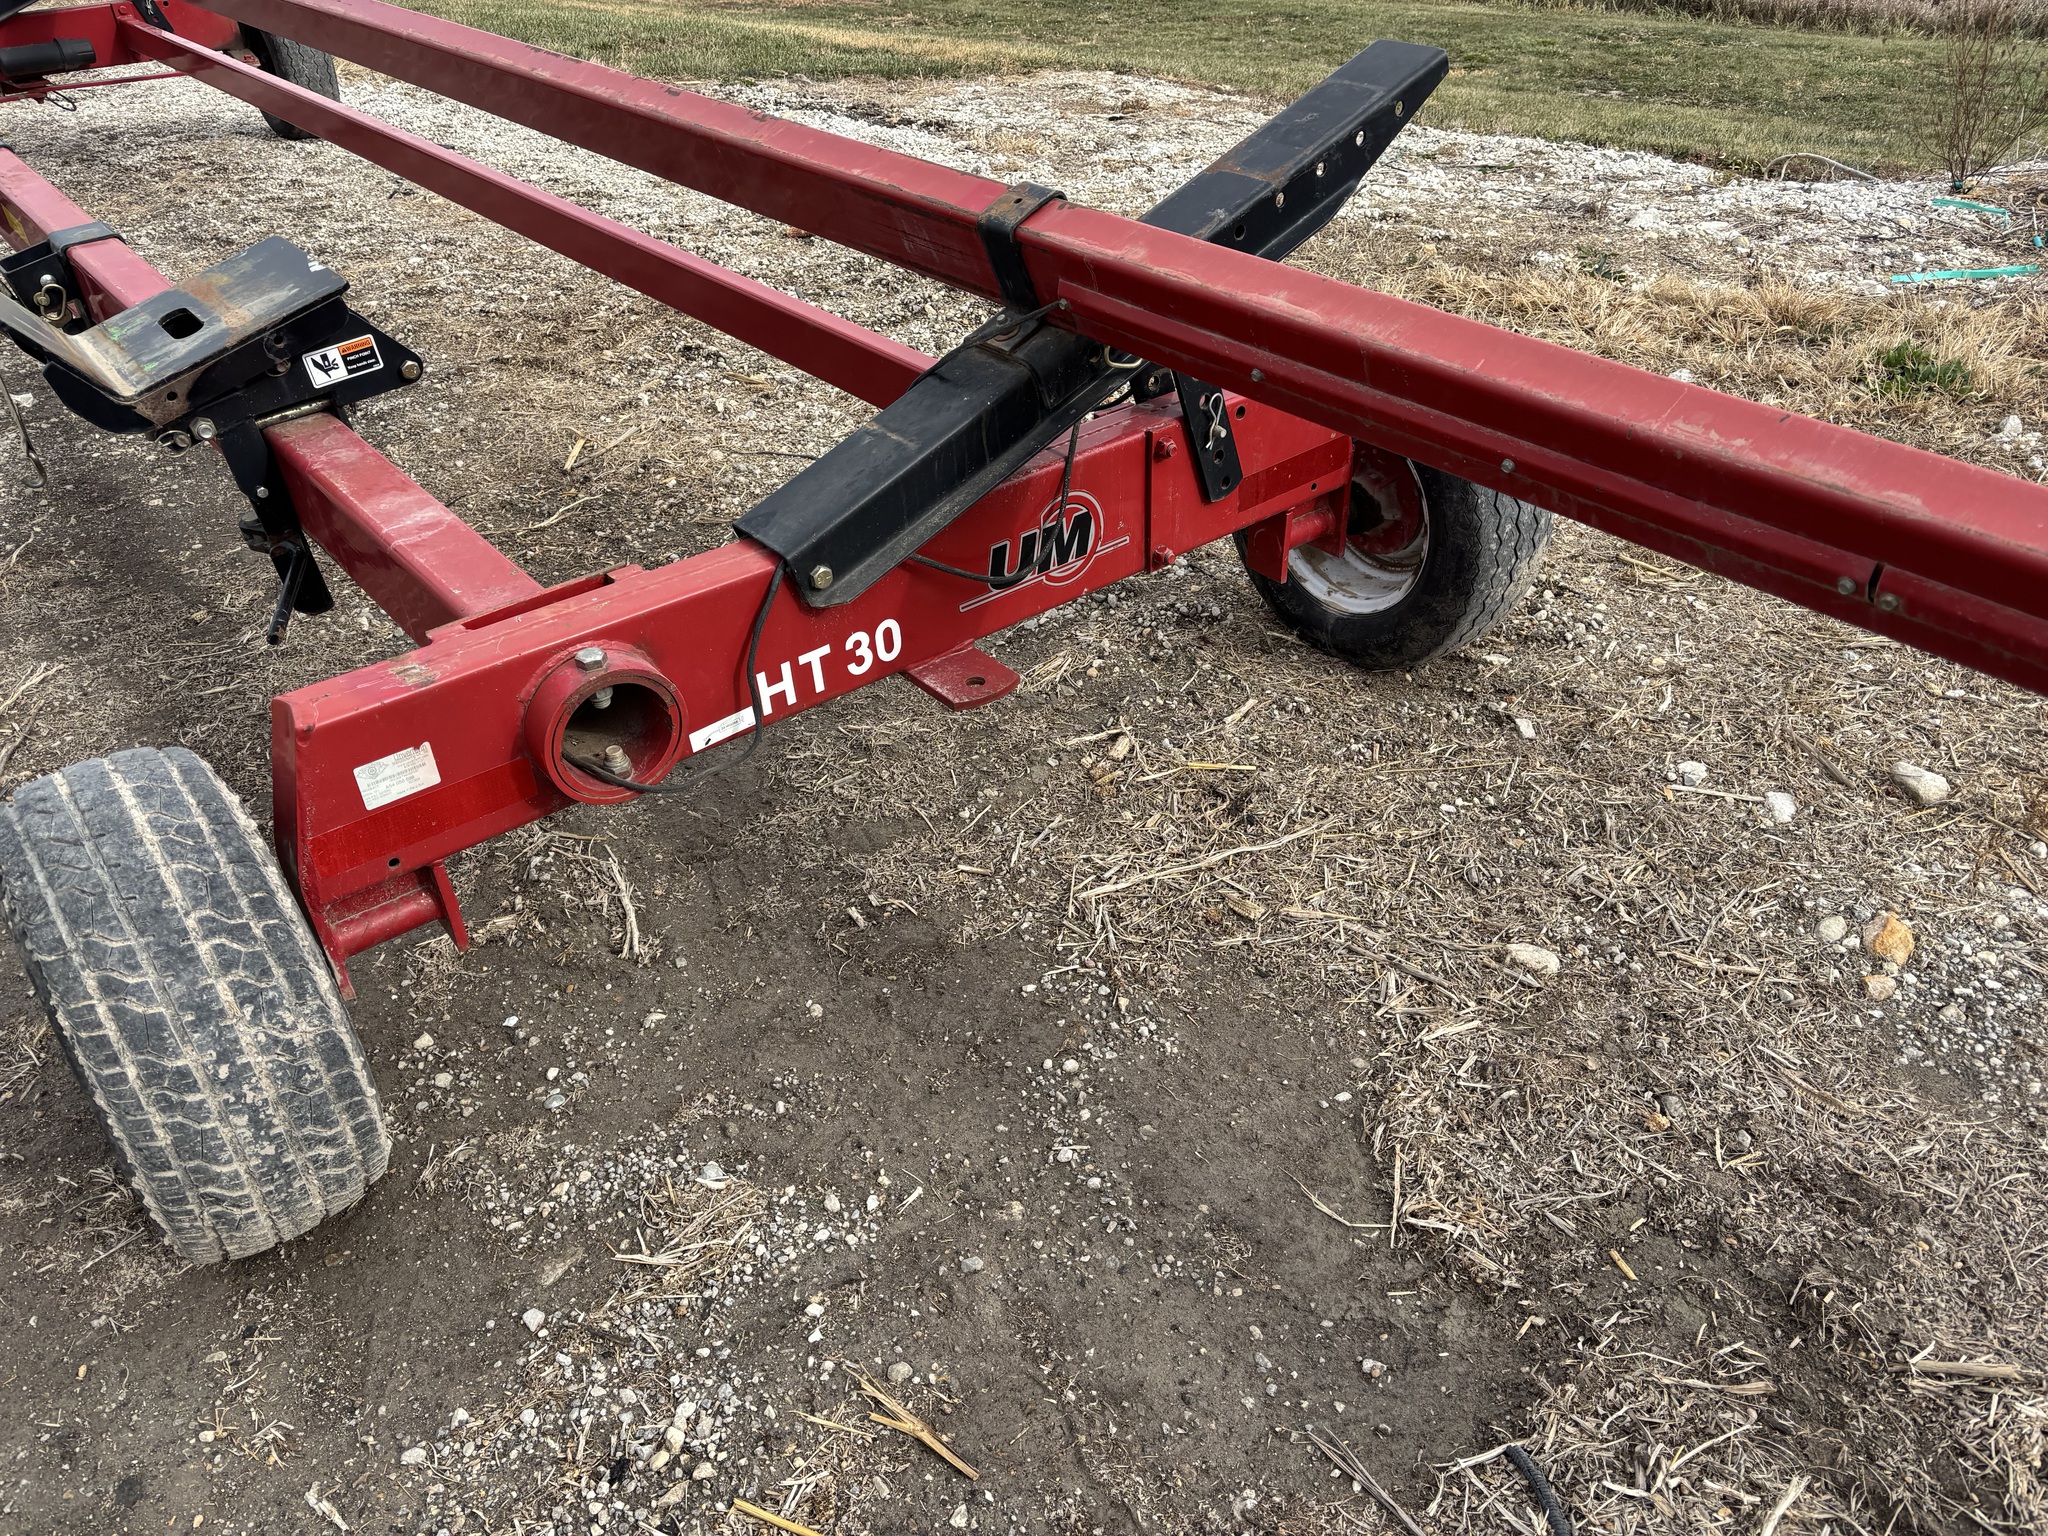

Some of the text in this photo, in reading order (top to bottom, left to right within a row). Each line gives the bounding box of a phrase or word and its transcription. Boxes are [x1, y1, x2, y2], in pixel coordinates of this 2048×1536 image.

[346, 339, 371, 352] WARNING
[988, 509, 1093, 591] UM
[756, 618, 902, 717] HT 30
